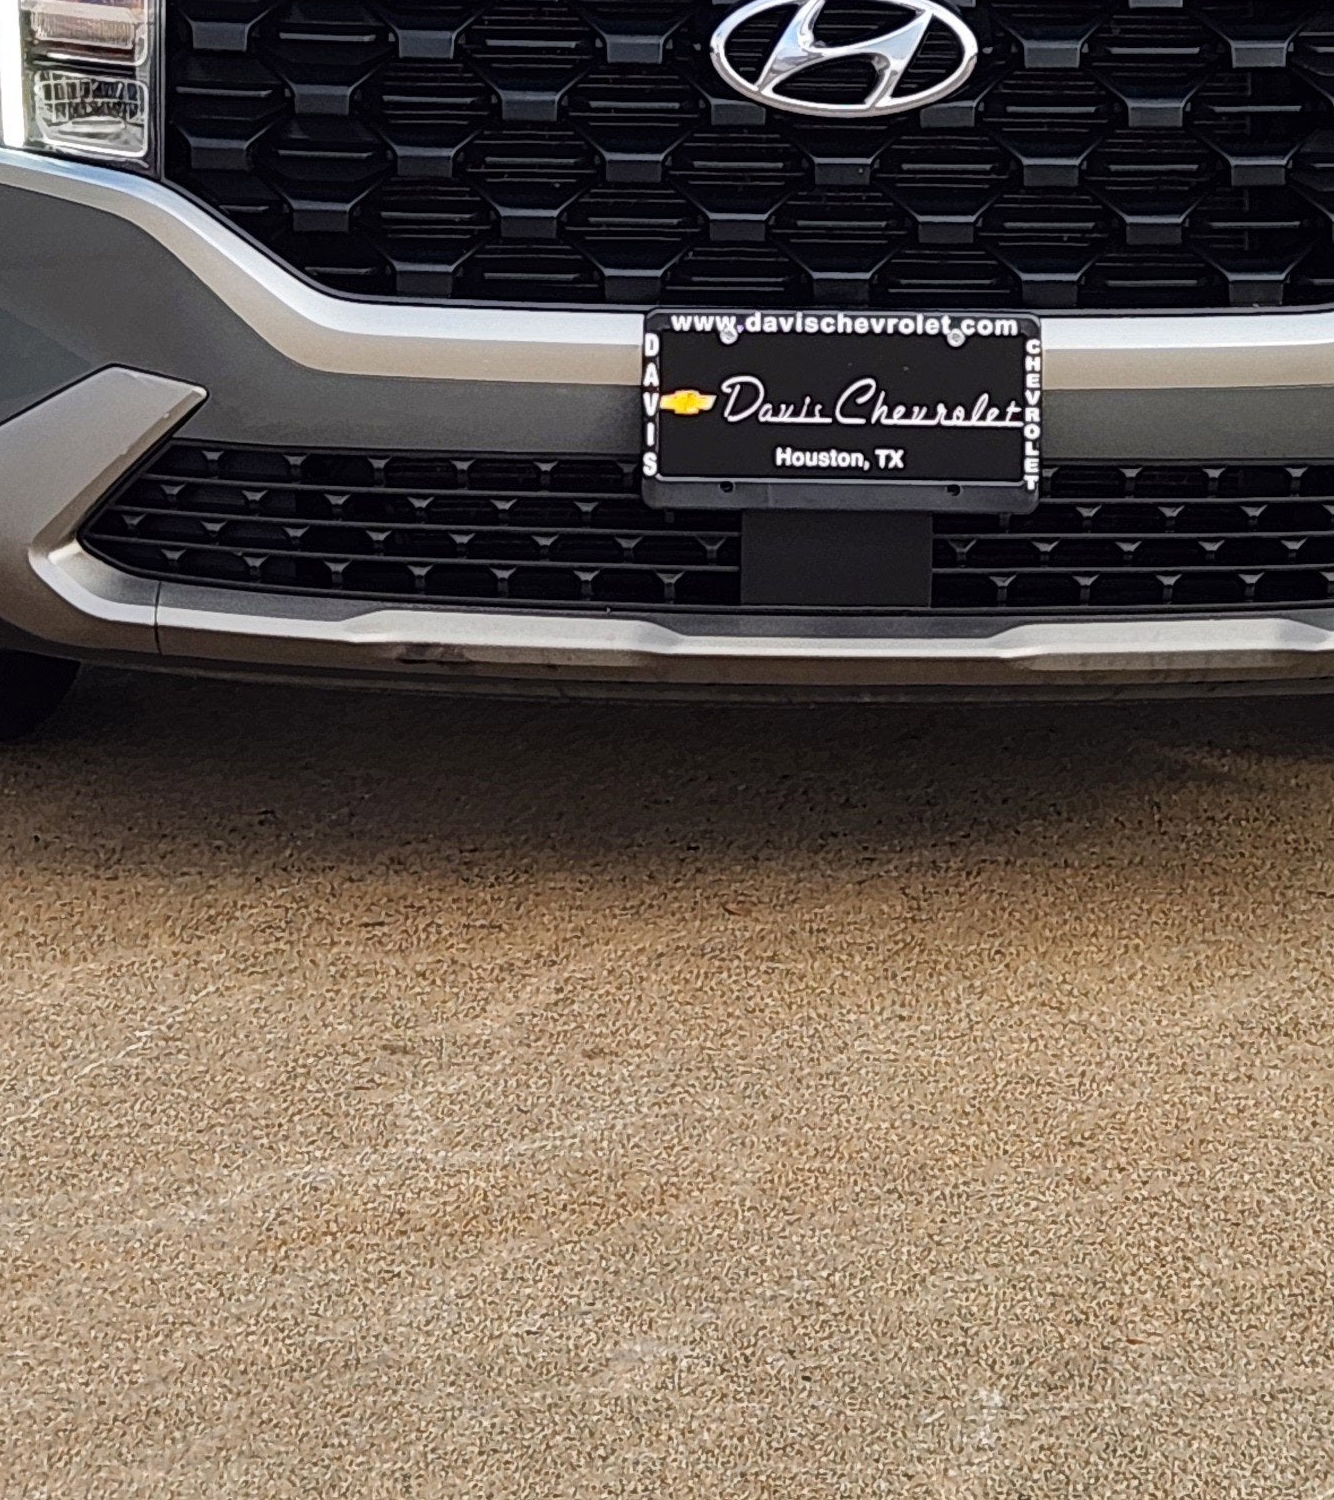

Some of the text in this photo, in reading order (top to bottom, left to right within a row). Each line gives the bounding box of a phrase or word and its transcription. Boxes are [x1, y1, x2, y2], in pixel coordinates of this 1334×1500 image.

[670, 311, 1018, 337] www.davischevroletcom
[642, 332, 660, 477] DAVIS
[720, 375, 1025, 428] Davis Chevrolet
[1023, 338, 1041, 490] CHEVROLET
[775, 446, 905, 471] Houston, TX
